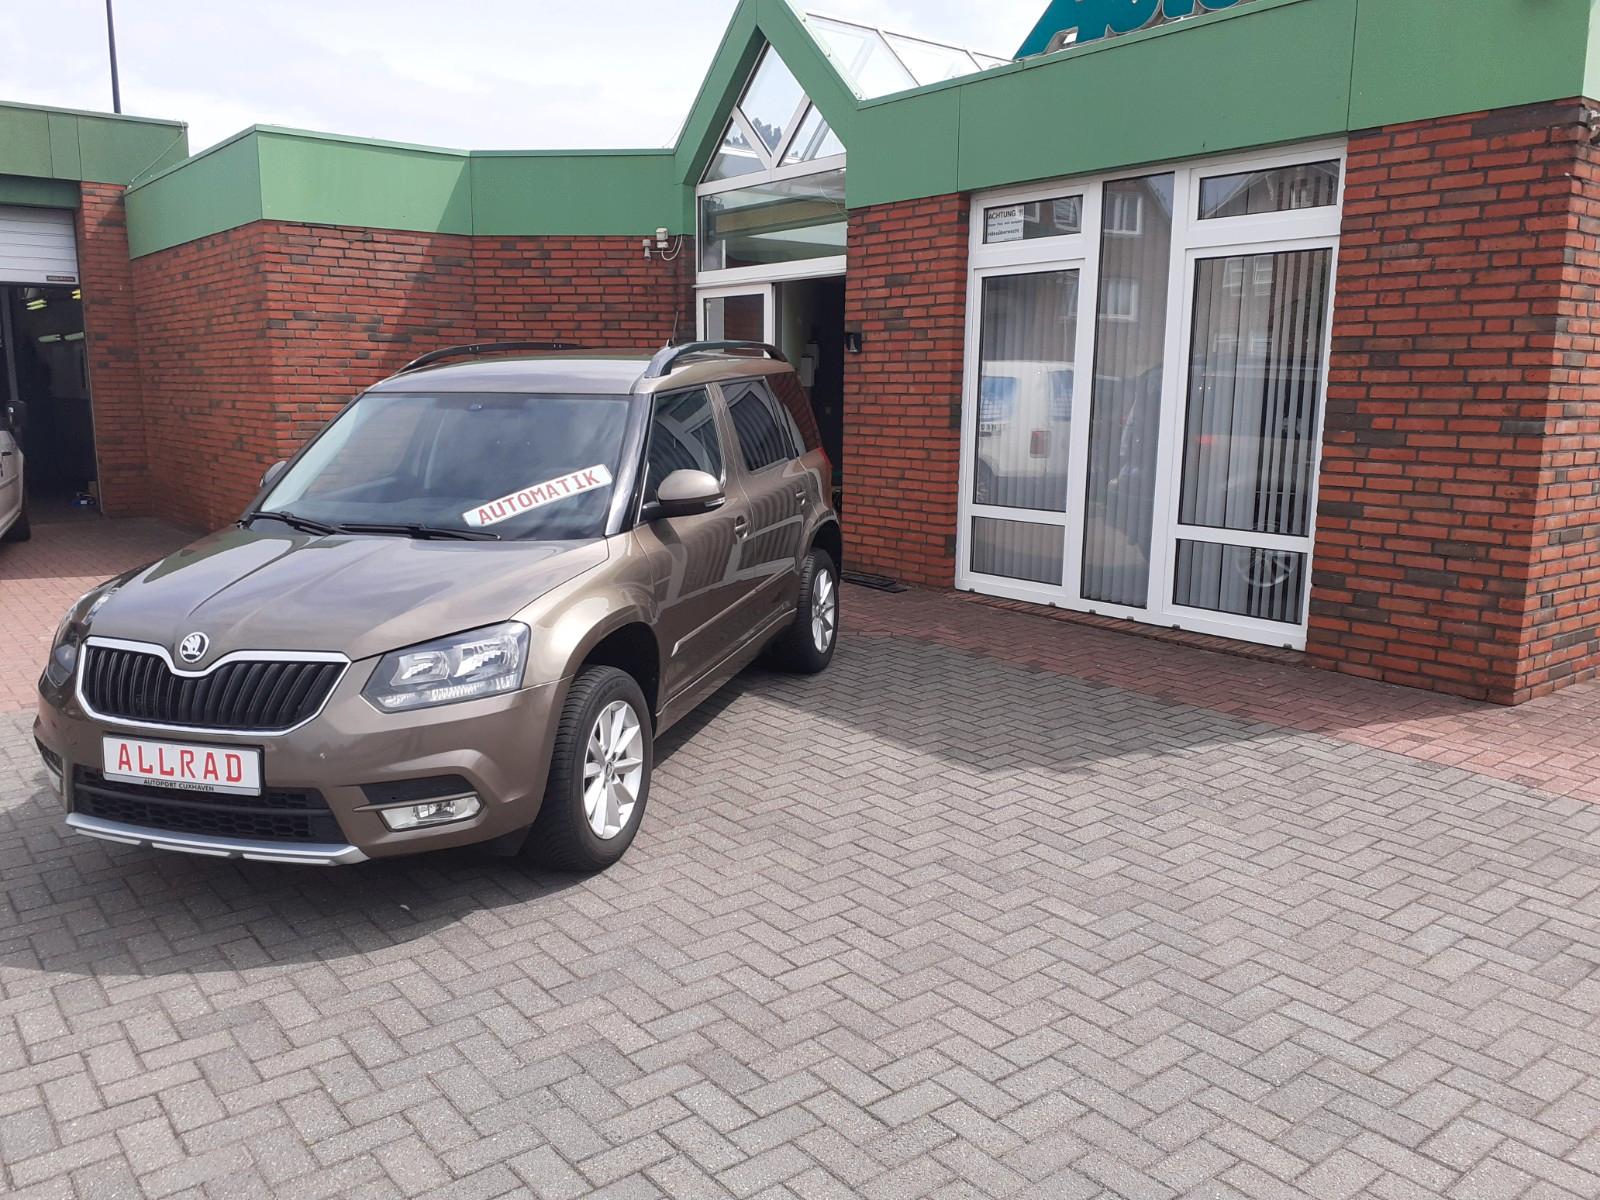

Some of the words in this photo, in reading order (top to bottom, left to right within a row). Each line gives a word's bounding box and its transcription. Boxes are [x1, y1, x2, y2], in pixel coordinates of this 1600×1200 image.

[988, 209, 1016, 220] ACHTUNG
[478, 470, 600, 525] AUTOMATIK
[118, 743, 242, 782] ALLRAD
[143, 779, 177, 789] AUTOPORT
[178, 783, 215, 792] CUXHAVEN
